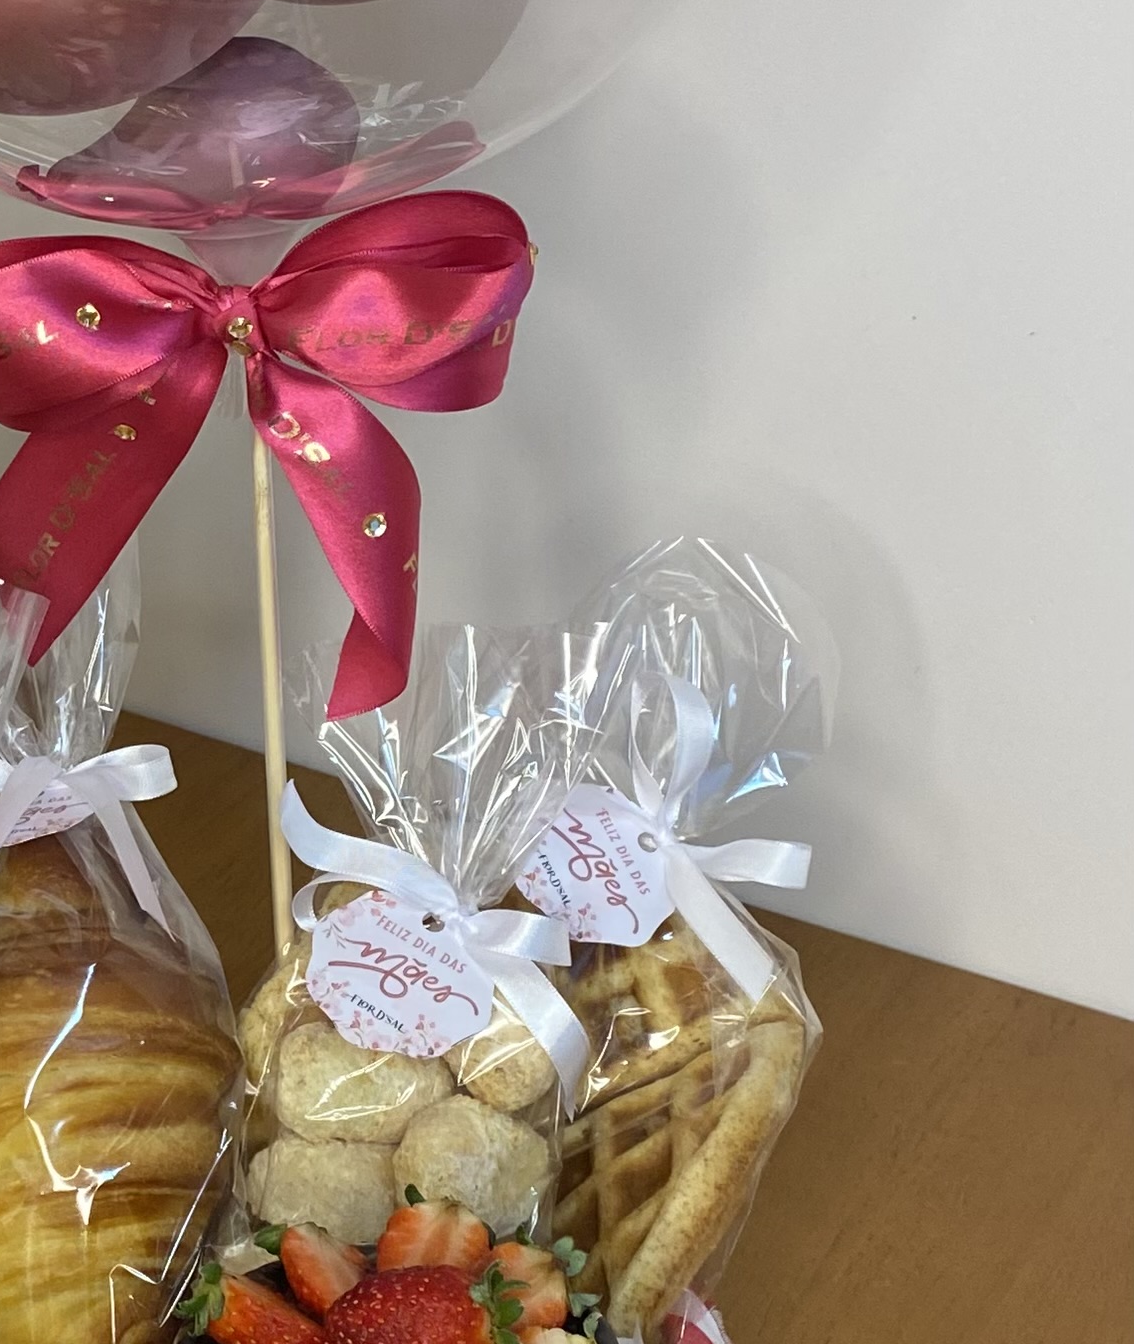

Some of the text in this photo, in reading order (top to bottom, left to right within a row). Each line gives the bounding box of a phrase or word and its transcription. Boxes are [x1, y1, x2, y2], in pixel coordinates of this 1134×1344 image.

[596, 807, 651, 896] FELIZ DIA DAS
[376, 915, 468, 974] FELIZ DIA DAS
